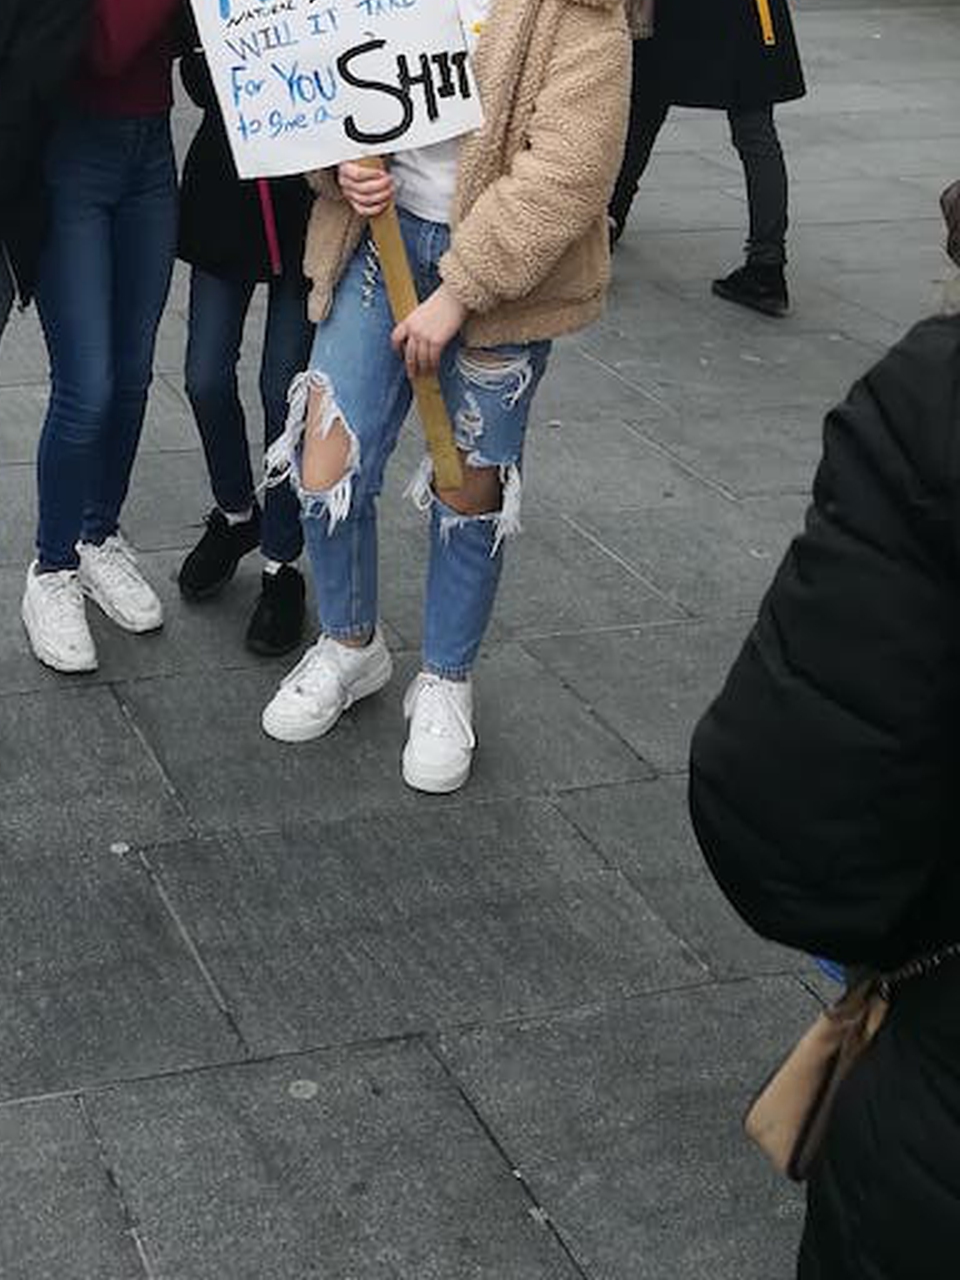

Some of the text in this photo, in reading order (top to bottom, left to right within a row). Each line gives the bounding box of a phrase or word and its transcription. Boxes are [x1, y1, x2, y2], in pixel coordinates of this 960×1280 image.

[224, 21, 299, 62] WILL
[306, 6, 340, 37] IT
[336, 38, 473, 146] SHIT
[236, 115, 262, 142] to
